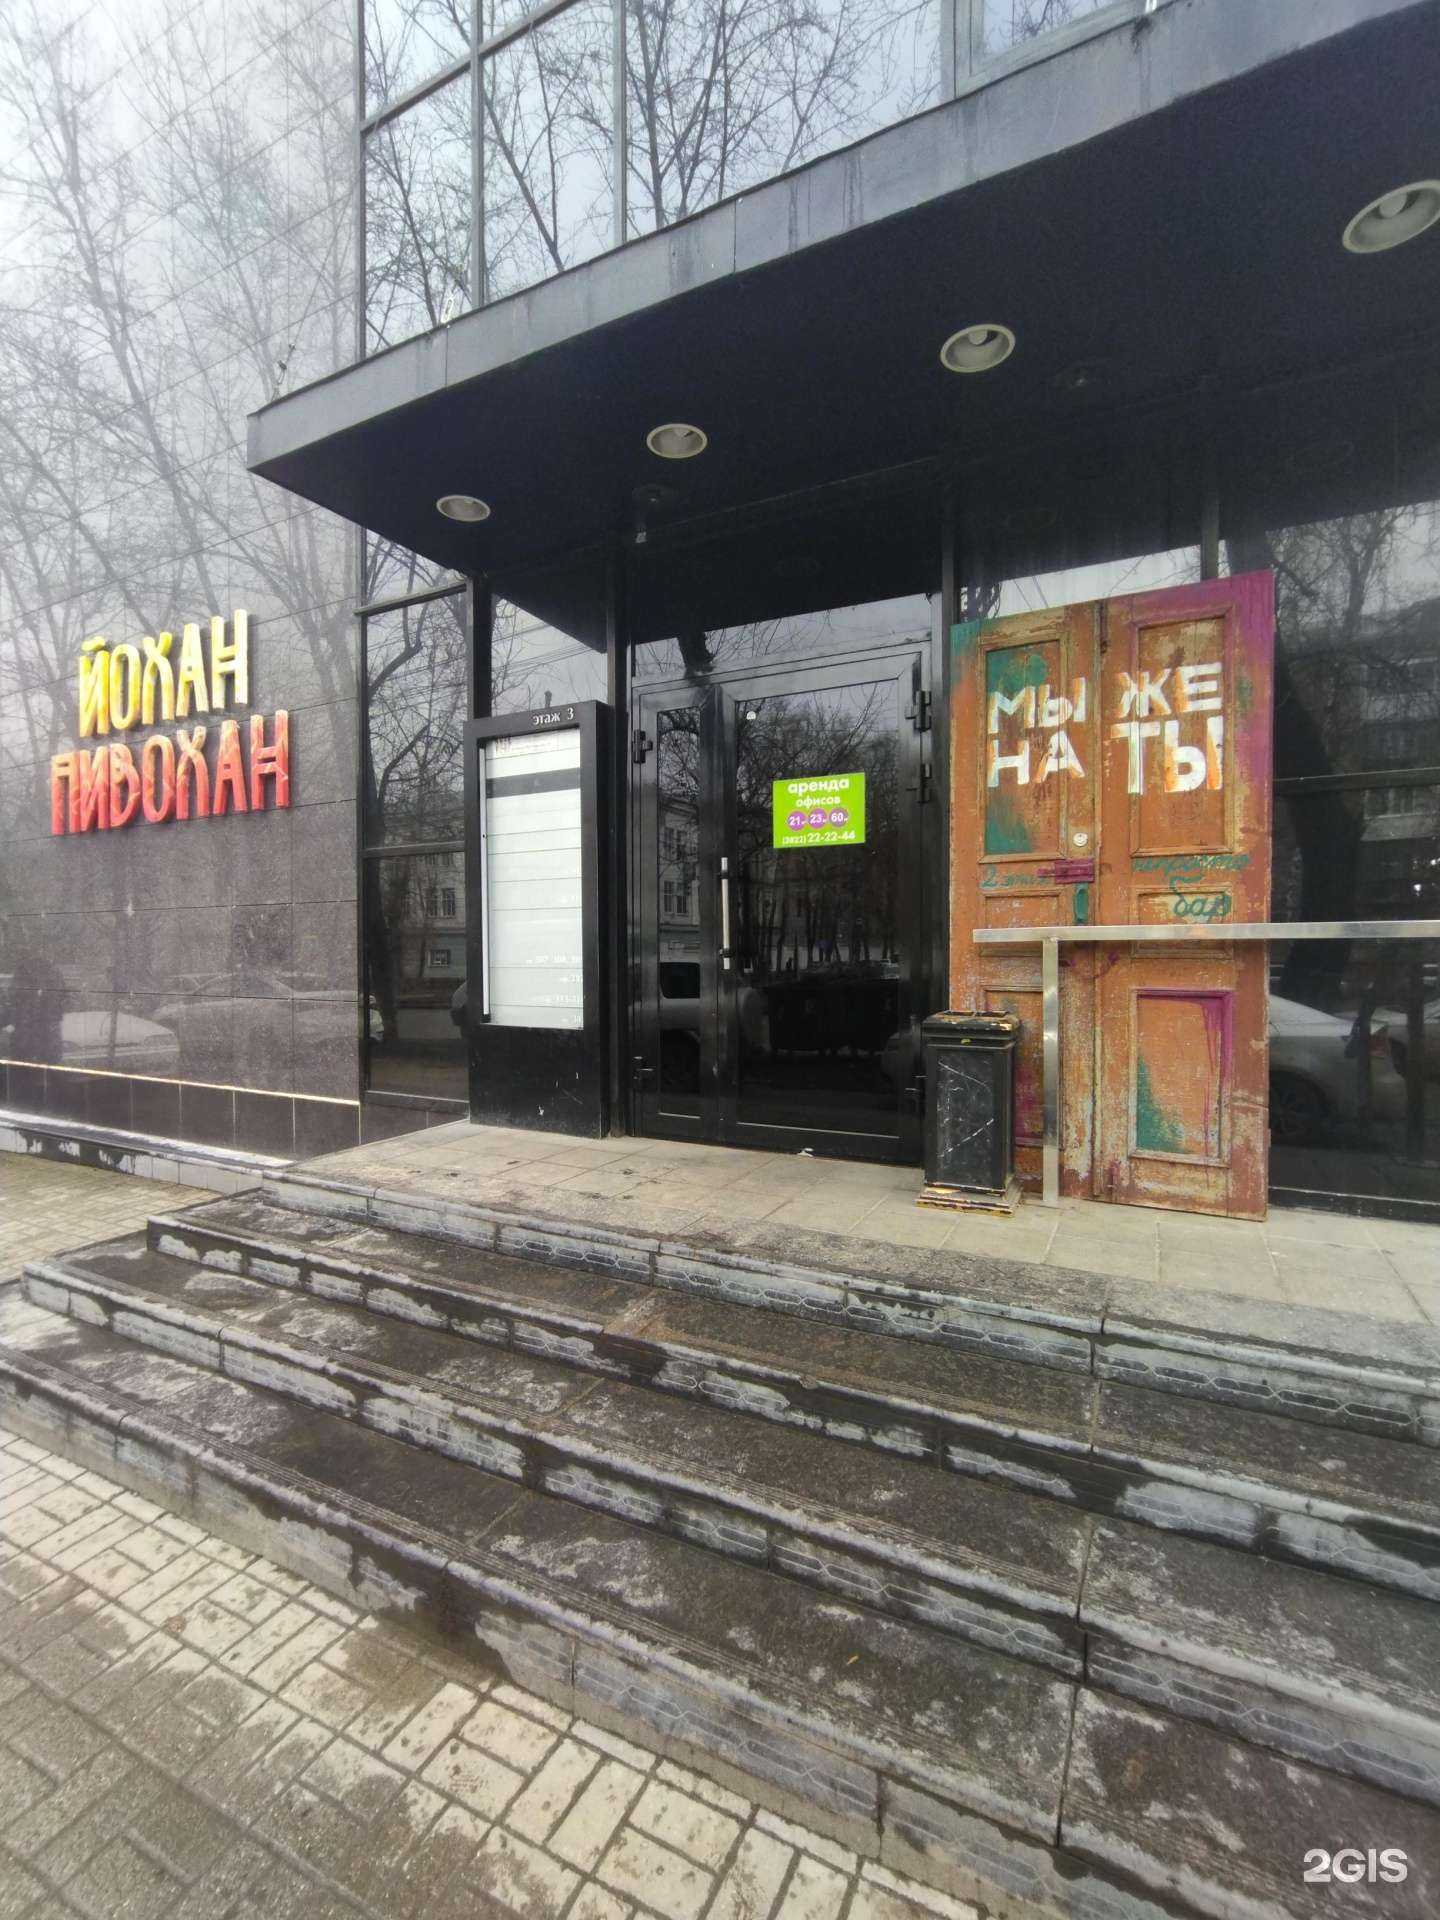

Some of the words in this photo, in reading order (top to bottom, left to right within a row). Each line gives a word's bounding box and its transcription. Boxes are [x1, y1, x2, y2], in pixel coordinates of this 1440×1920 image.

[78, 608, 248, 737] ЙОХАН
[987, 677, 1087, 735] МЫ
[1114, 661, 1223, 719] ЖЕ
[532, 712, 561, 726] этаж
[567, 707, 574, 721] 3
[51, 709, 289, 836] ПИВОХАН
[787, 778, 849, 797] аренда
[987, 730, 1086, 788] НА
[1110, 715, 1225, 795] ТЫ
[795, 795, 841, 809] офисов
